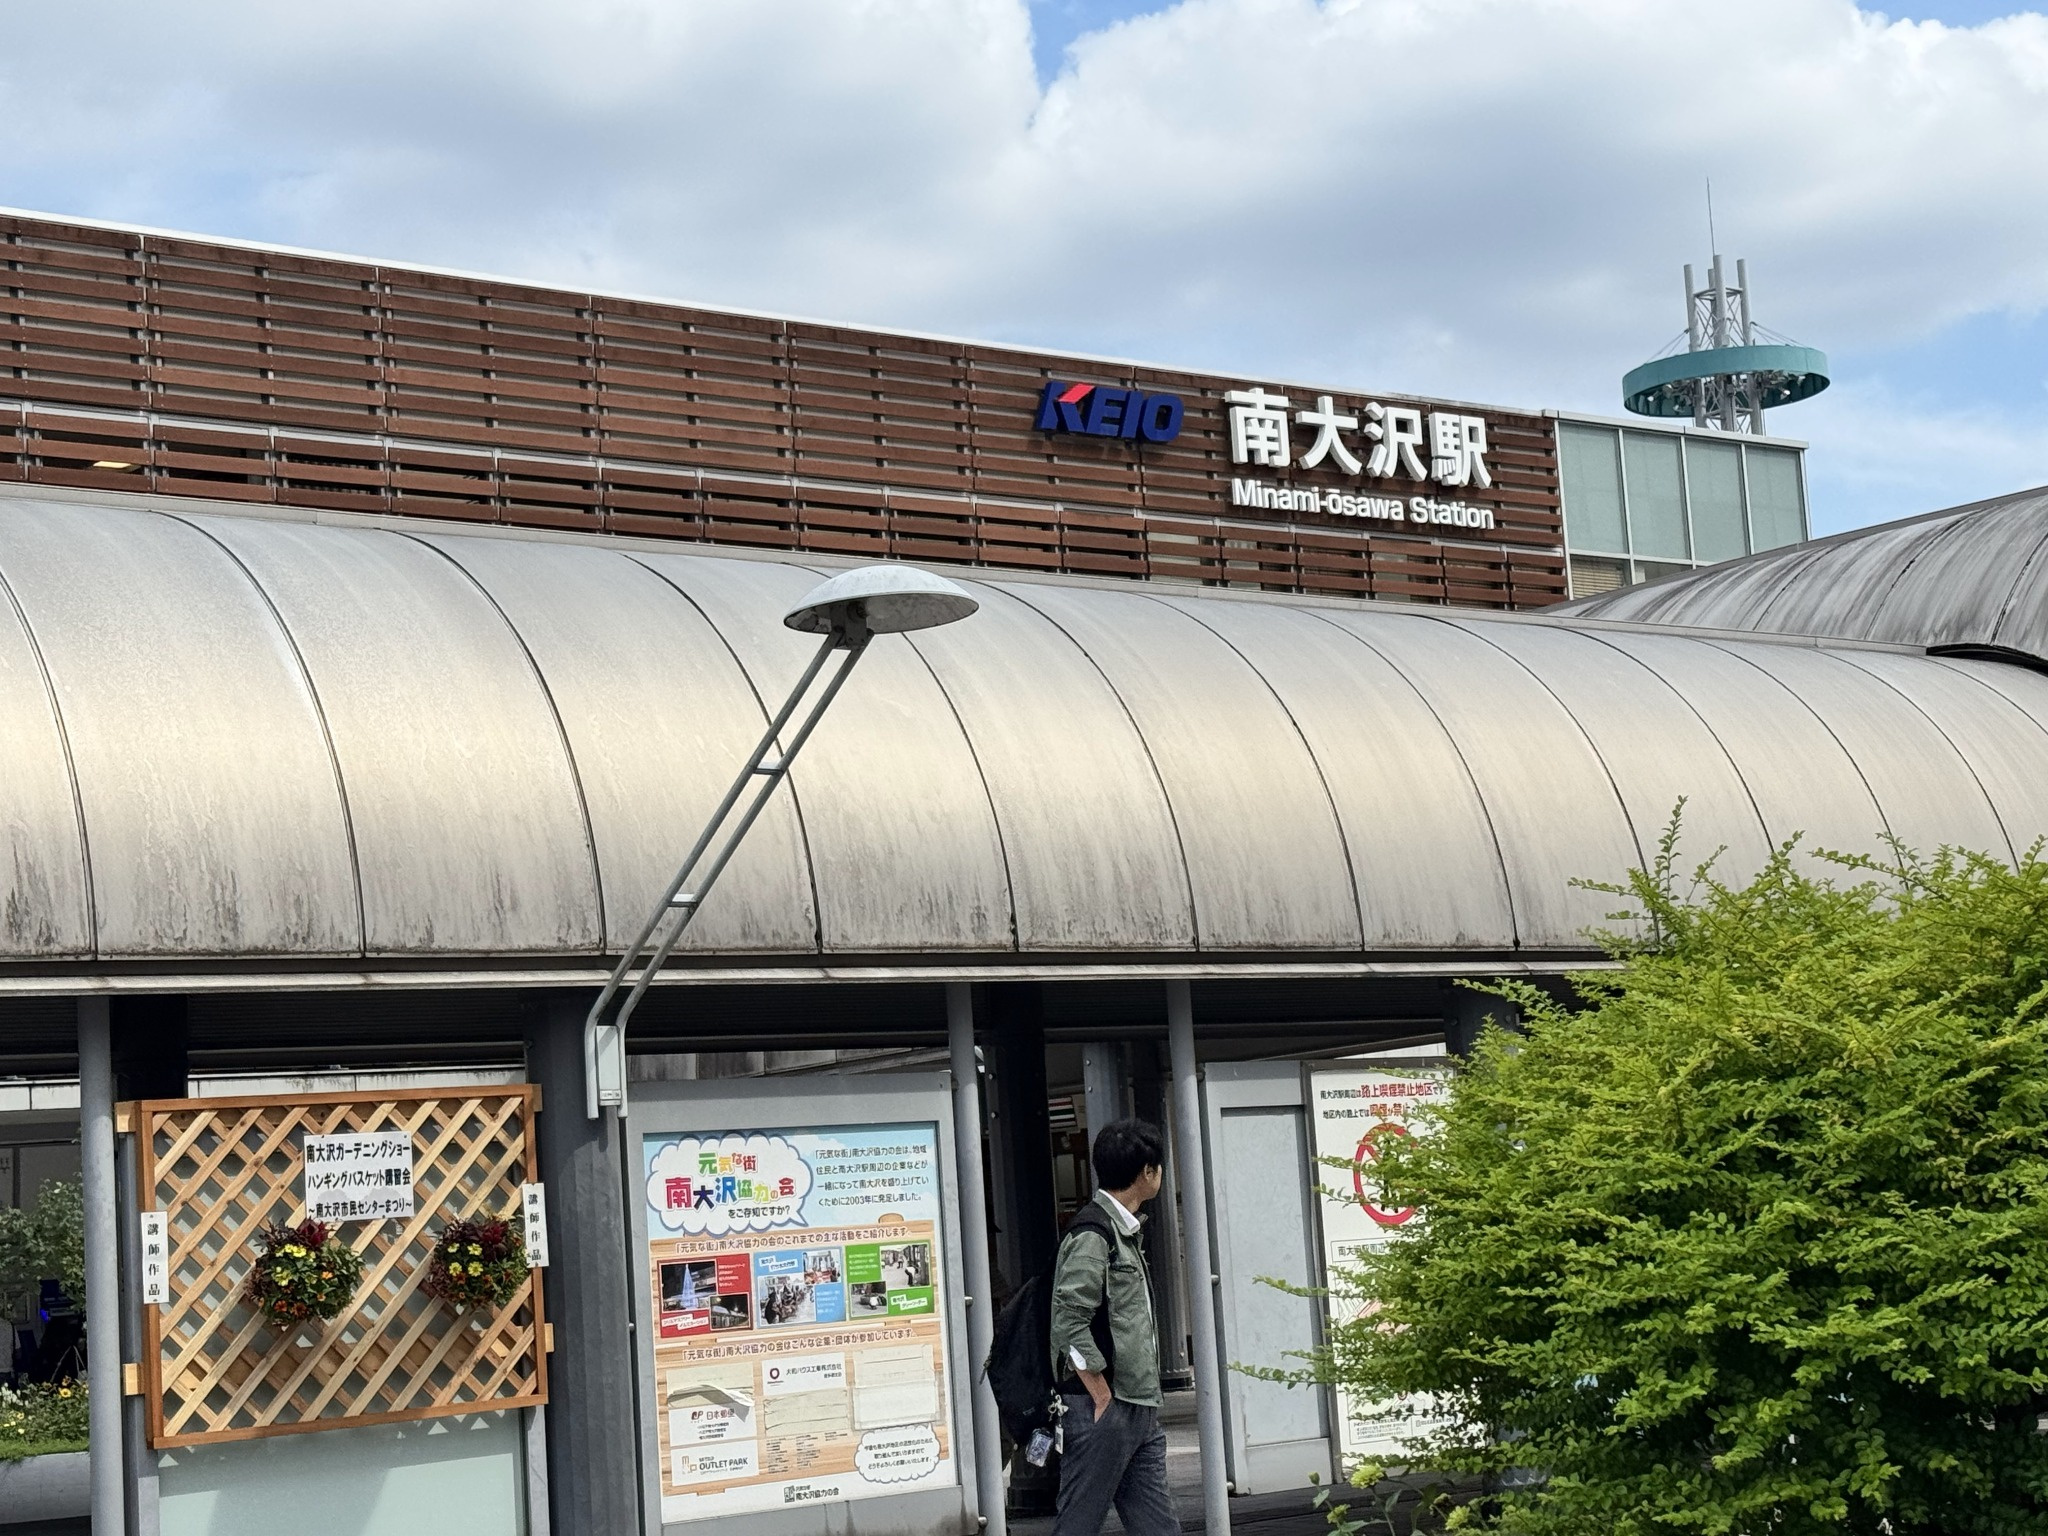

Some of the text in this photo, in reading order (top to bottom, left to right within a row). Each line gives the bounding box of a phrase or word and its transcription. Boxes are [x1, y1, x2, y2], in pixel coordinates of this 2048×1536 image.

[1037, 381, 1184, 442] KEIO
[1224, 387, 1492, 489] 南大沢駅
[1409, 496, 1494, 529] Station
[306, 1140, 410, 1163] 南大沢ガーデニングショー
[698, 1152, 757, 1174] 元気な街
[308, 1167, 411, 1190] ハンギングバスケット講習会
[665, 1176, 794, 1210] 南大沢協力の会
[528, 1194, 541, 1261] 講師作品
[147, 1223, 160, 1296] 講師作品
[699, 1460, 728, 1471] OUTLET
[728, 1457, 749, 1467] PARK
